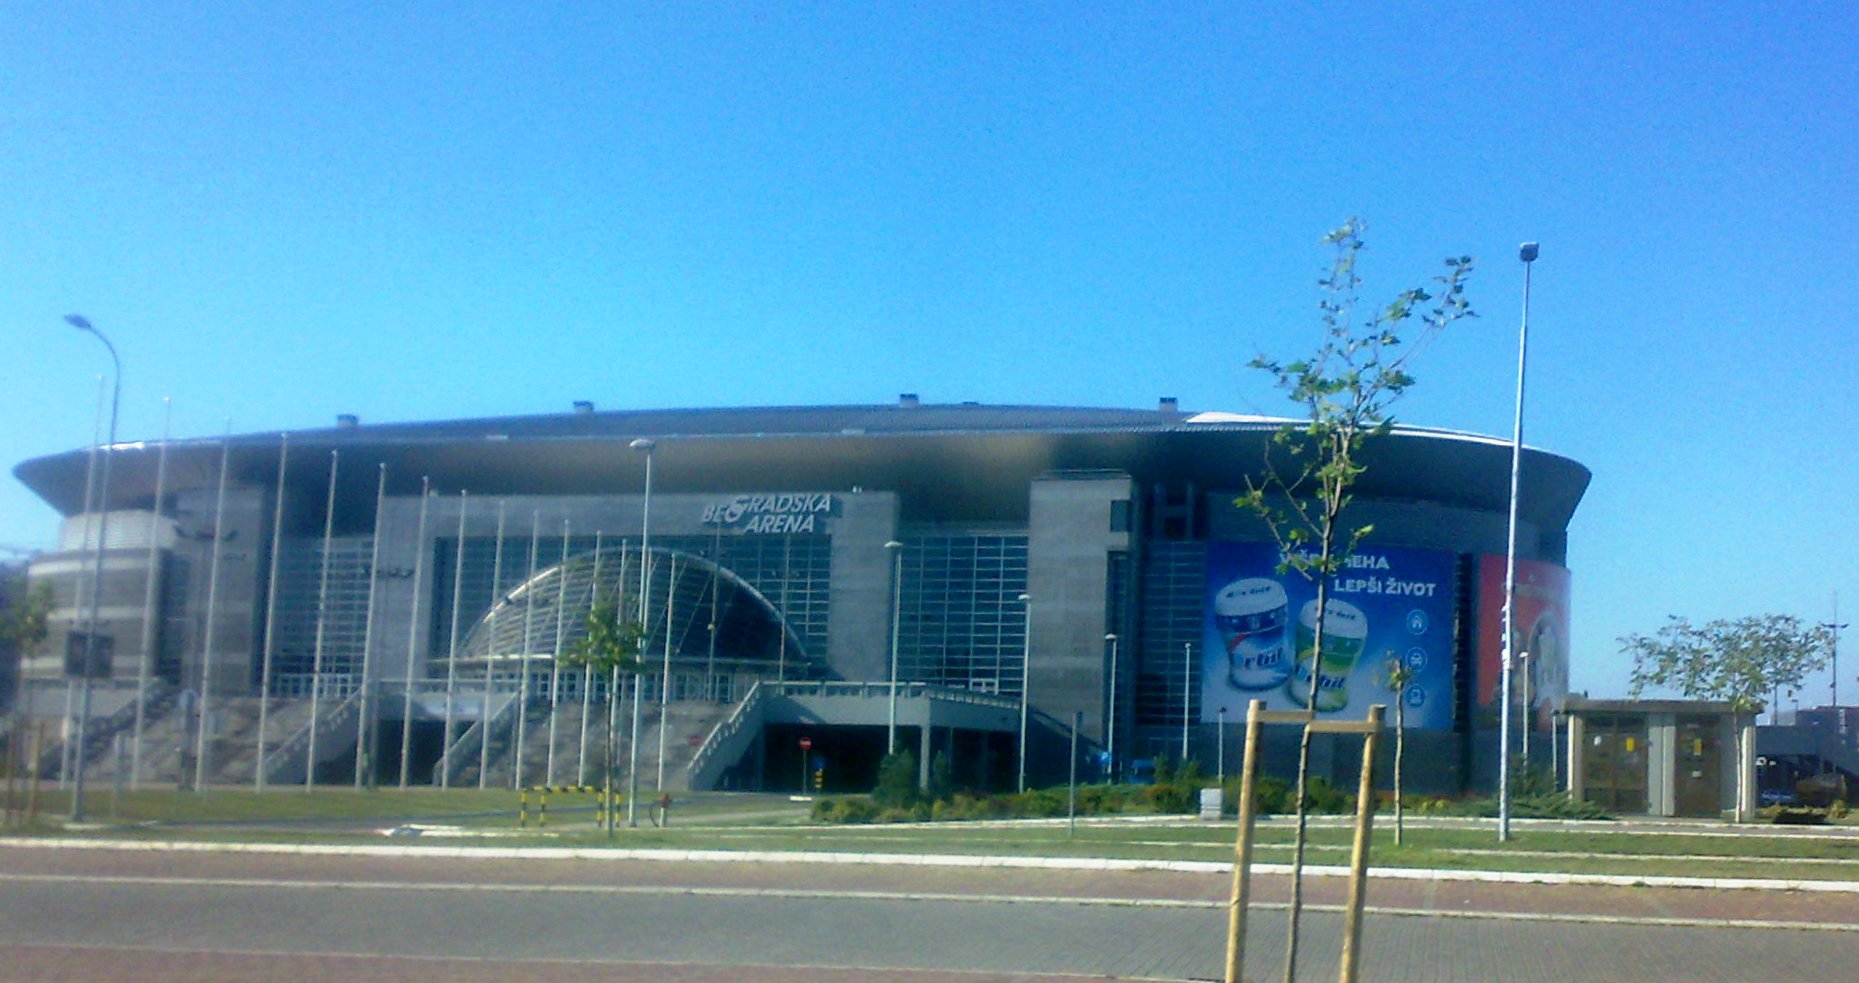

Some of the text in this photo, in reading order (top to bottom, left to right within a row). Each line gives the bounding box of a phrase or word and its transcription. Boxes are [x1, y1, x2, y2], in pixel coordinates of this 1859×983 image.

[744, 514, 815, 533] ARENA
[1334, 575, 1436, 597] LEPŠI ŽIVOT
